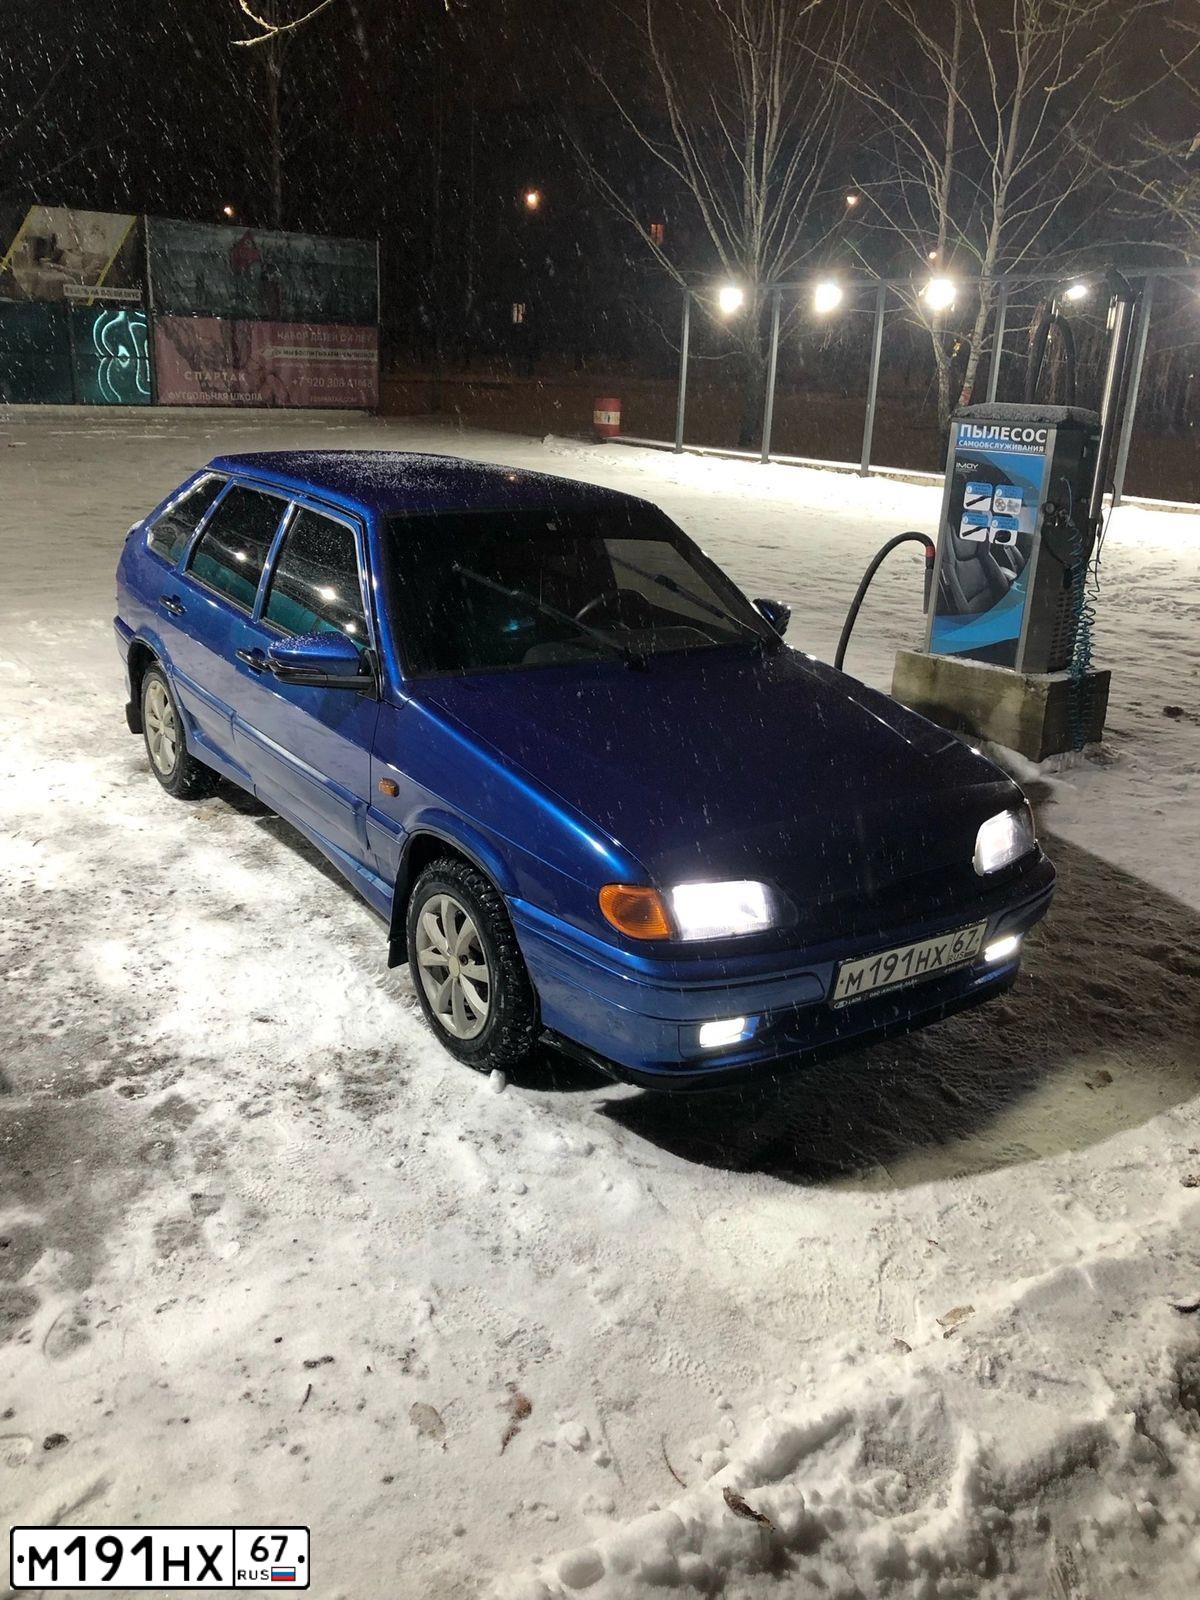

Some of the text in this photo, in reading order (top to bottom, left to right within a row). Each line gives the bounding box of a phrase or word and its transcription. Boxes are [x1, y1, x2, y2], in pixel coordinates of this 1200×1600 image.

[184, 371, 246, 381] СПАРТАК
[168, 391, 263, 401] ФУТБОЛЬНАЯ ШКОЛА
[960, 424, 1047, 443] ПЫЛЕСОС
[958, 440, 1044, 453] САМООБСЛУЖИВАНИЯ
[952, 928, 979, 953] 67
[947, 952, 965, 962] RUS
[845, 943, 947, 995] М191НХ
